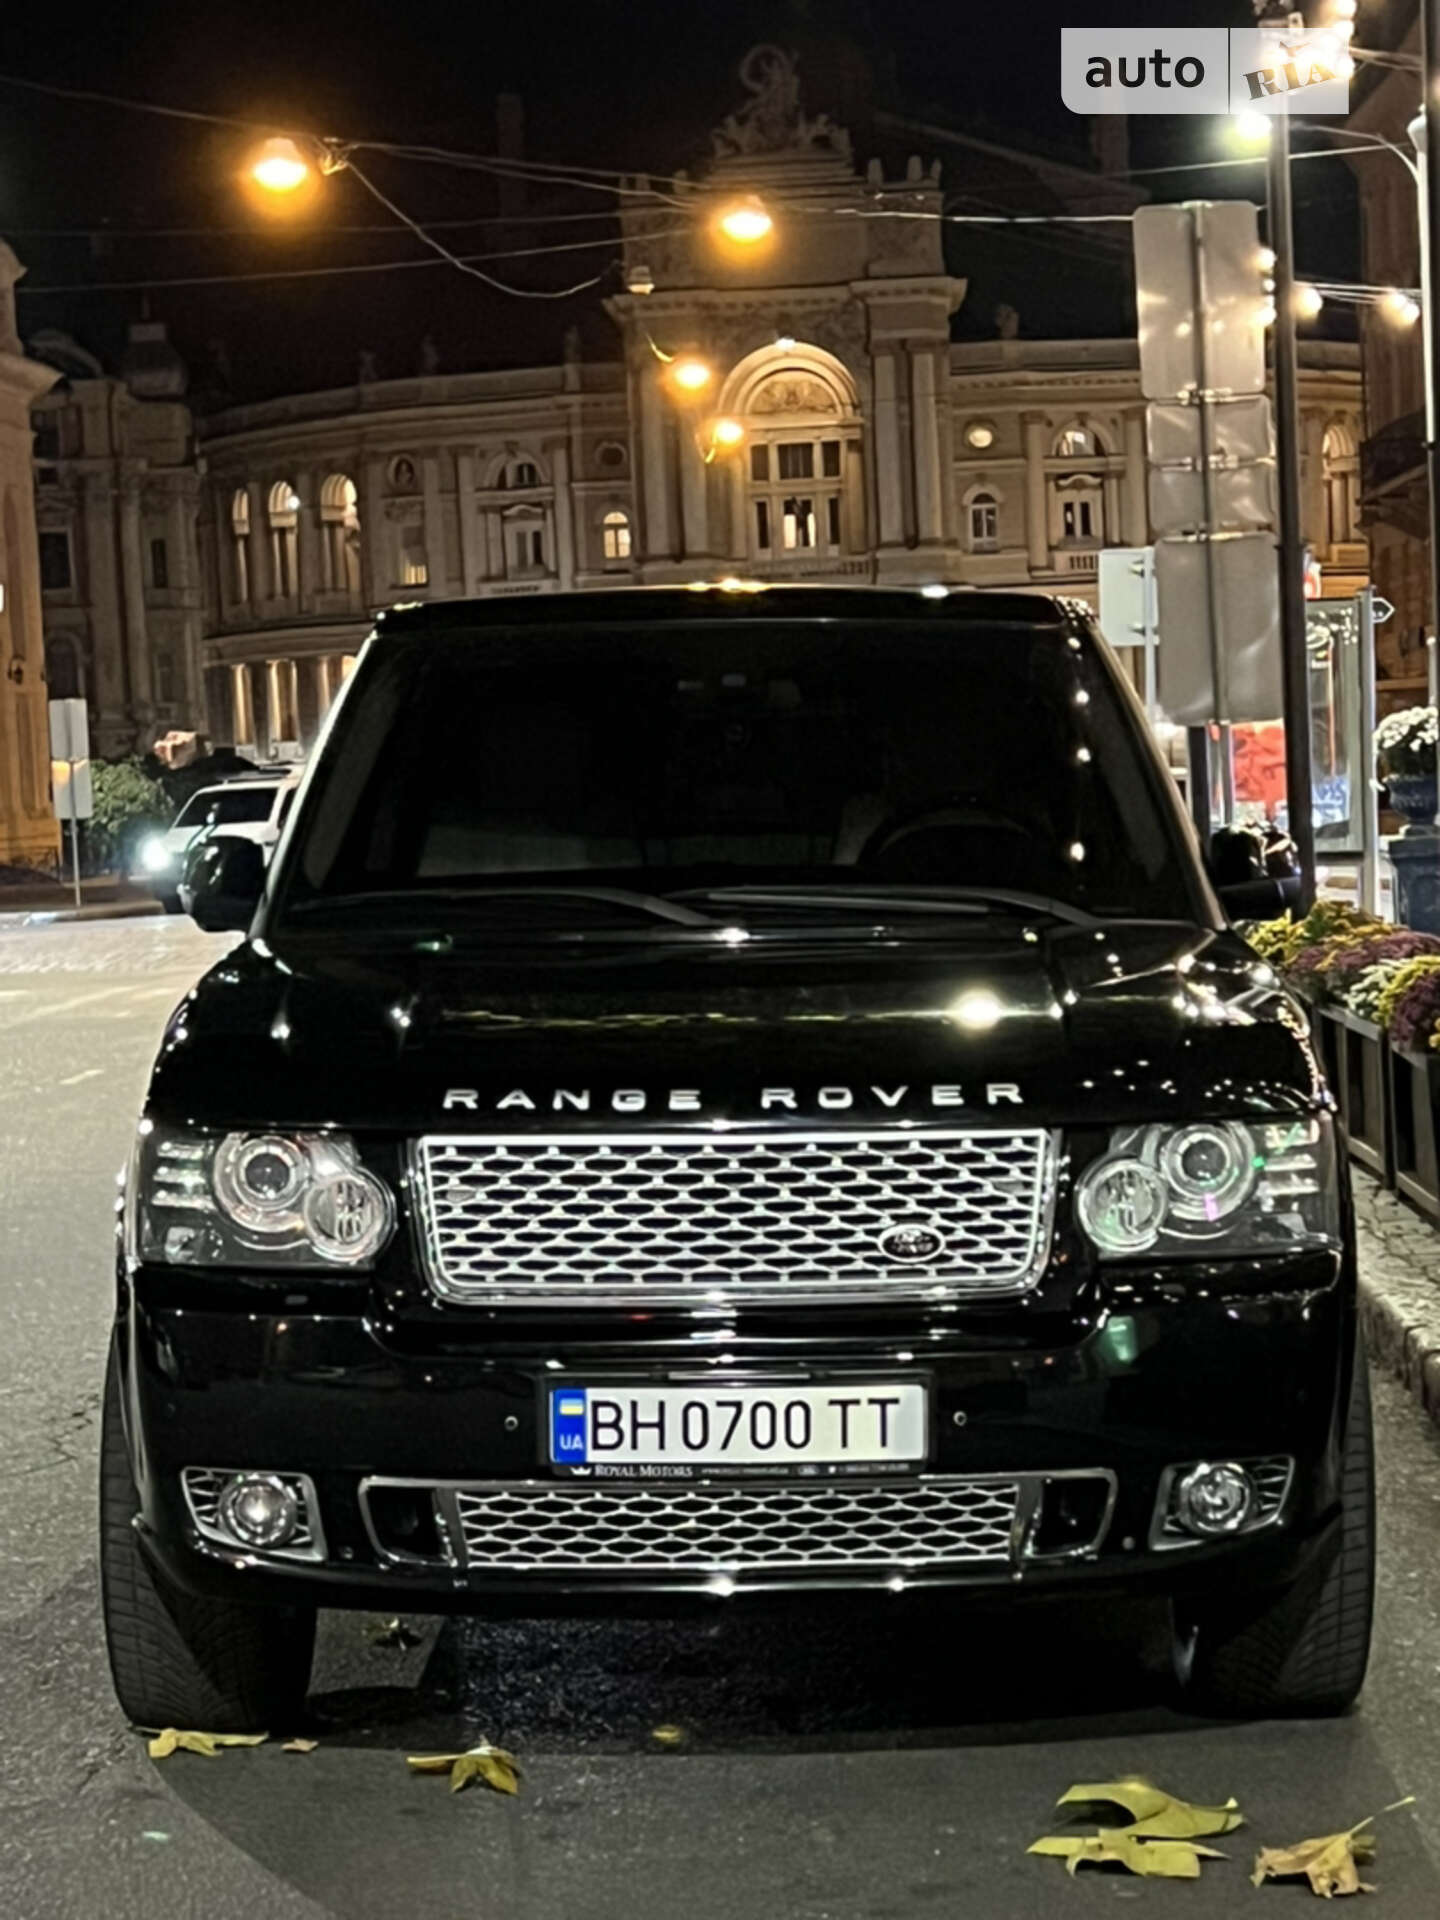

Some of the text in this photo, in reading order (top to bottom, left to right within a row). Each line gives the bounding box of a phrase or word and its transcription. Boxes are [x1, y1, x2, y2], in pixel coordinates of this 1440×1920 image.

[443, 1083, 1024, 1110] RANGE ROVER
[591, 1398, 901, 1451] BH 0700 TT
[559, 1434, 584, 1451] UA
[594, 1464, 638, 1477] ROYAL
[639, 1464, 693, 1477] MOTORS
